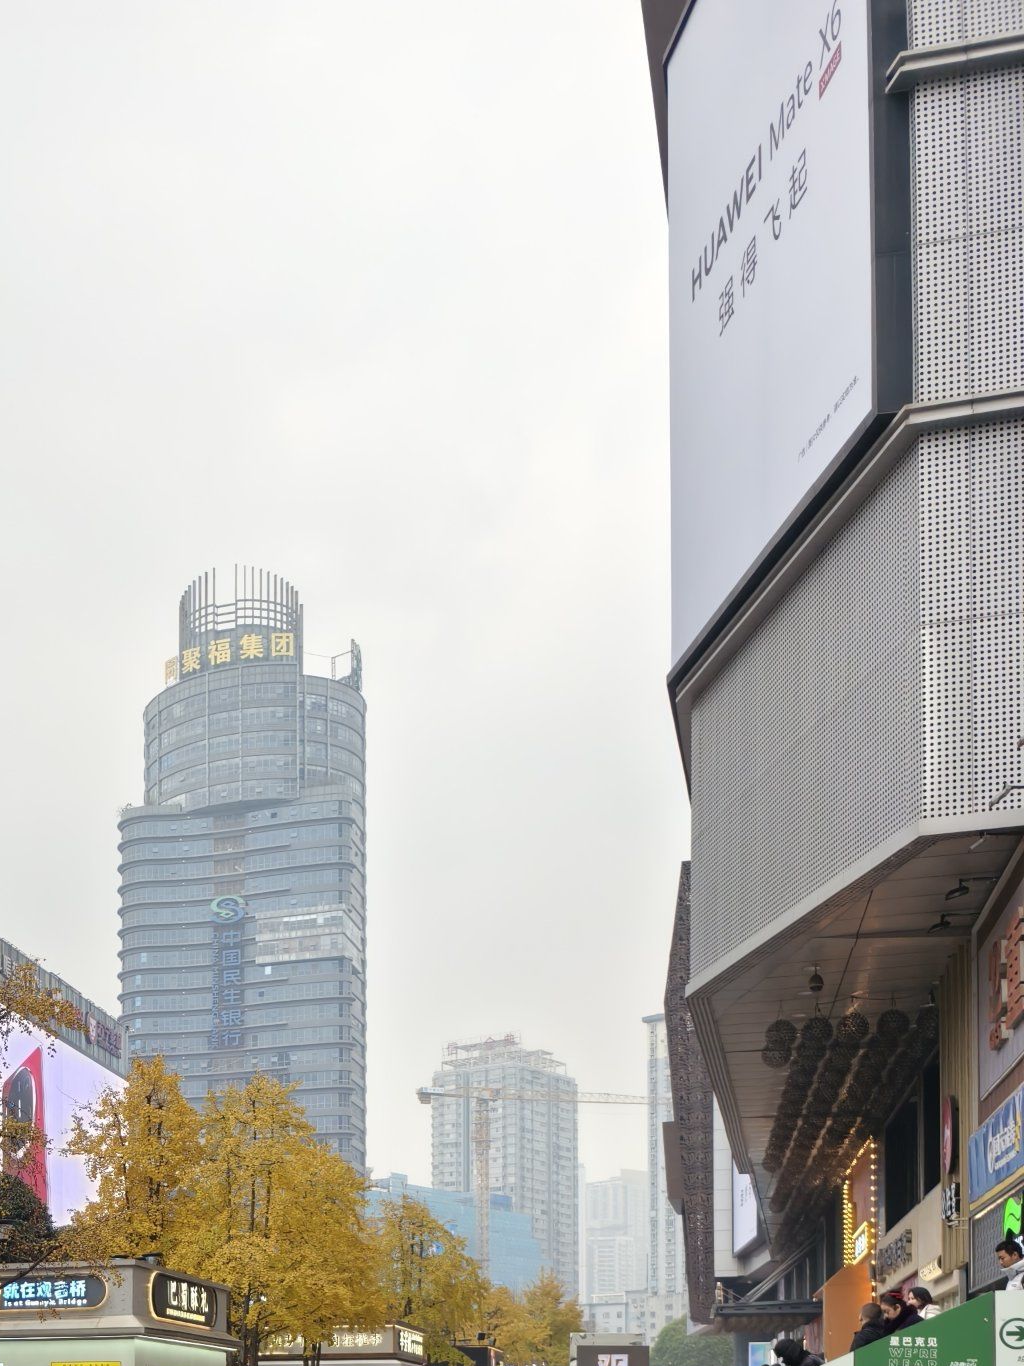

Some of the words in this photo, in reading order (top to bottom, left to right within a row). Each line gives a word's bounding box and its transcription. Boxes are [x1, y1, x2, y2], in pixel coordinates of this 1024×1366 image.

[690, 144, 763, 303] HUAWEI
[768, 61, 813, 161] Mate
[819, 0, 842, 71] X6
[718, 148, 808, 336] 强得飞起
[221, 929, 242, 1047] 中国民生银行
[2, 1280, 86, 1299] 就在观音桥
[888, 1348, 937, 1358] WE'RE
